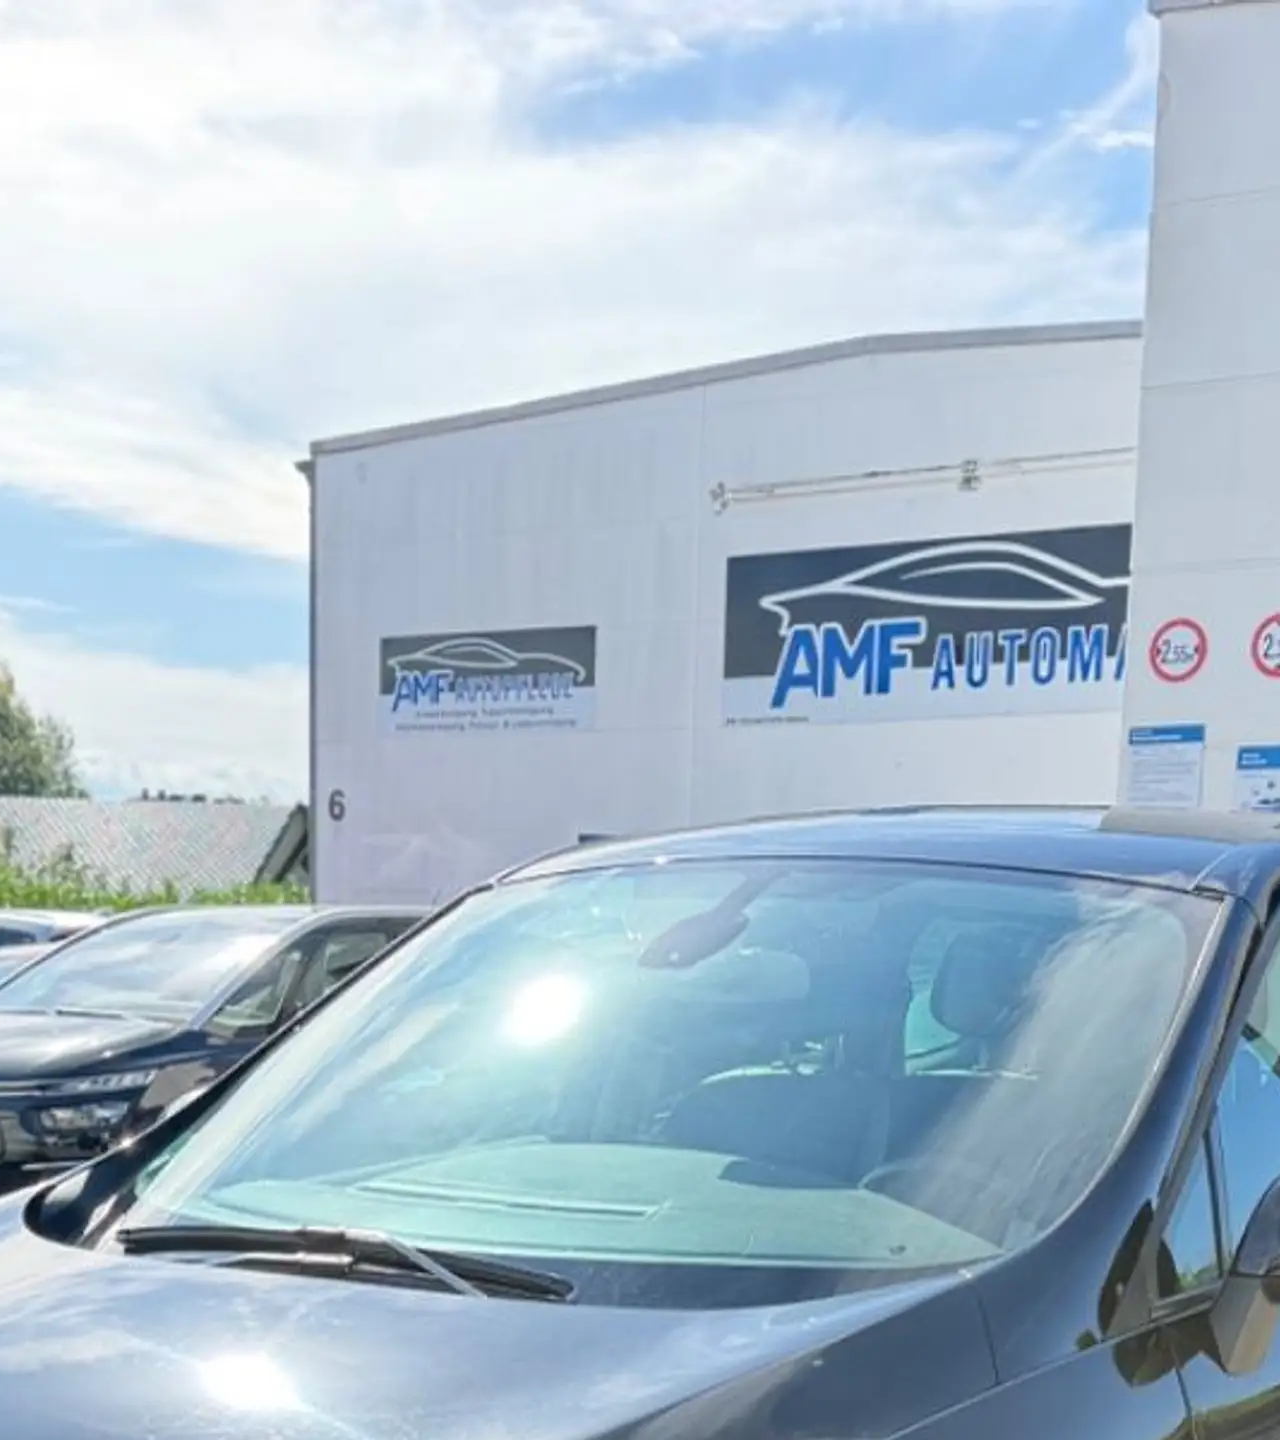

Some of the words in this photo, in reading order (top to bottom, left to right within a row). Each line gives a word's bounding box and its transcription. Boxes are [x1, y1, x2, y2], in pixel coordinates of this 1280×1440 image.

[770, 616, 926, 709] AMF
[391, 669, 454, 713] AMF
[328, 788, 346, 822] 6
